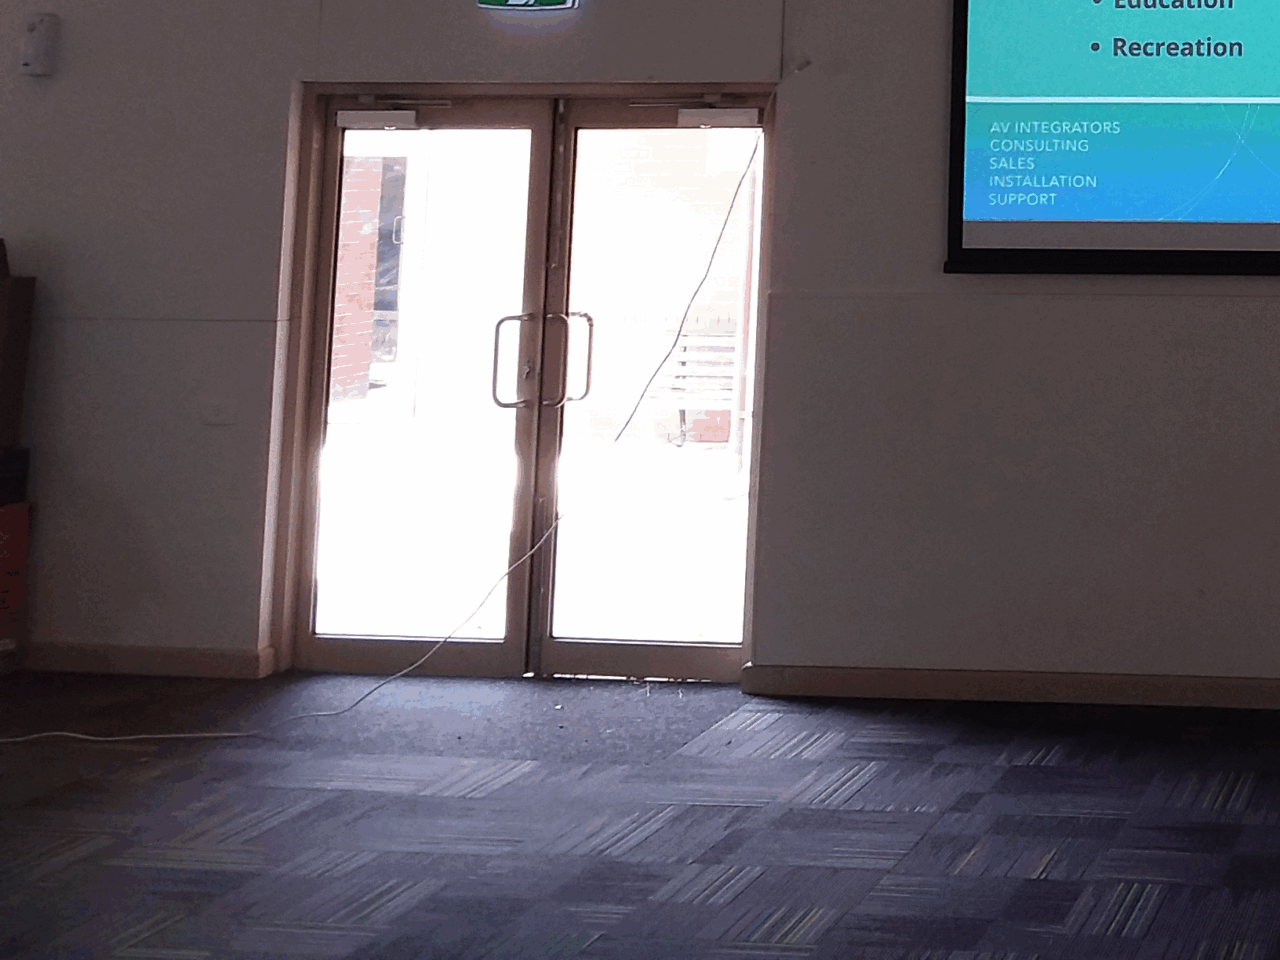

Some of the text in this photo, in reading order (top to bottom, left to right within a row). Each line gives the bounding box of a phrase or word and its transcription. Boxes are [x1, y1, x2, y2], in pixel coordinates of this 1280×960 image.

[1112, 37, 1244, 58] Recreation
[990, 120, 1121, 135] AV INTEGRATORS
[990, 138, 1089, 152] CONSULTING
[989, 156, 1035, 170] SALES
[989, 174, 1098, 188] INSTALLATION
[988, 192, 1058, 207] SUPPORT
